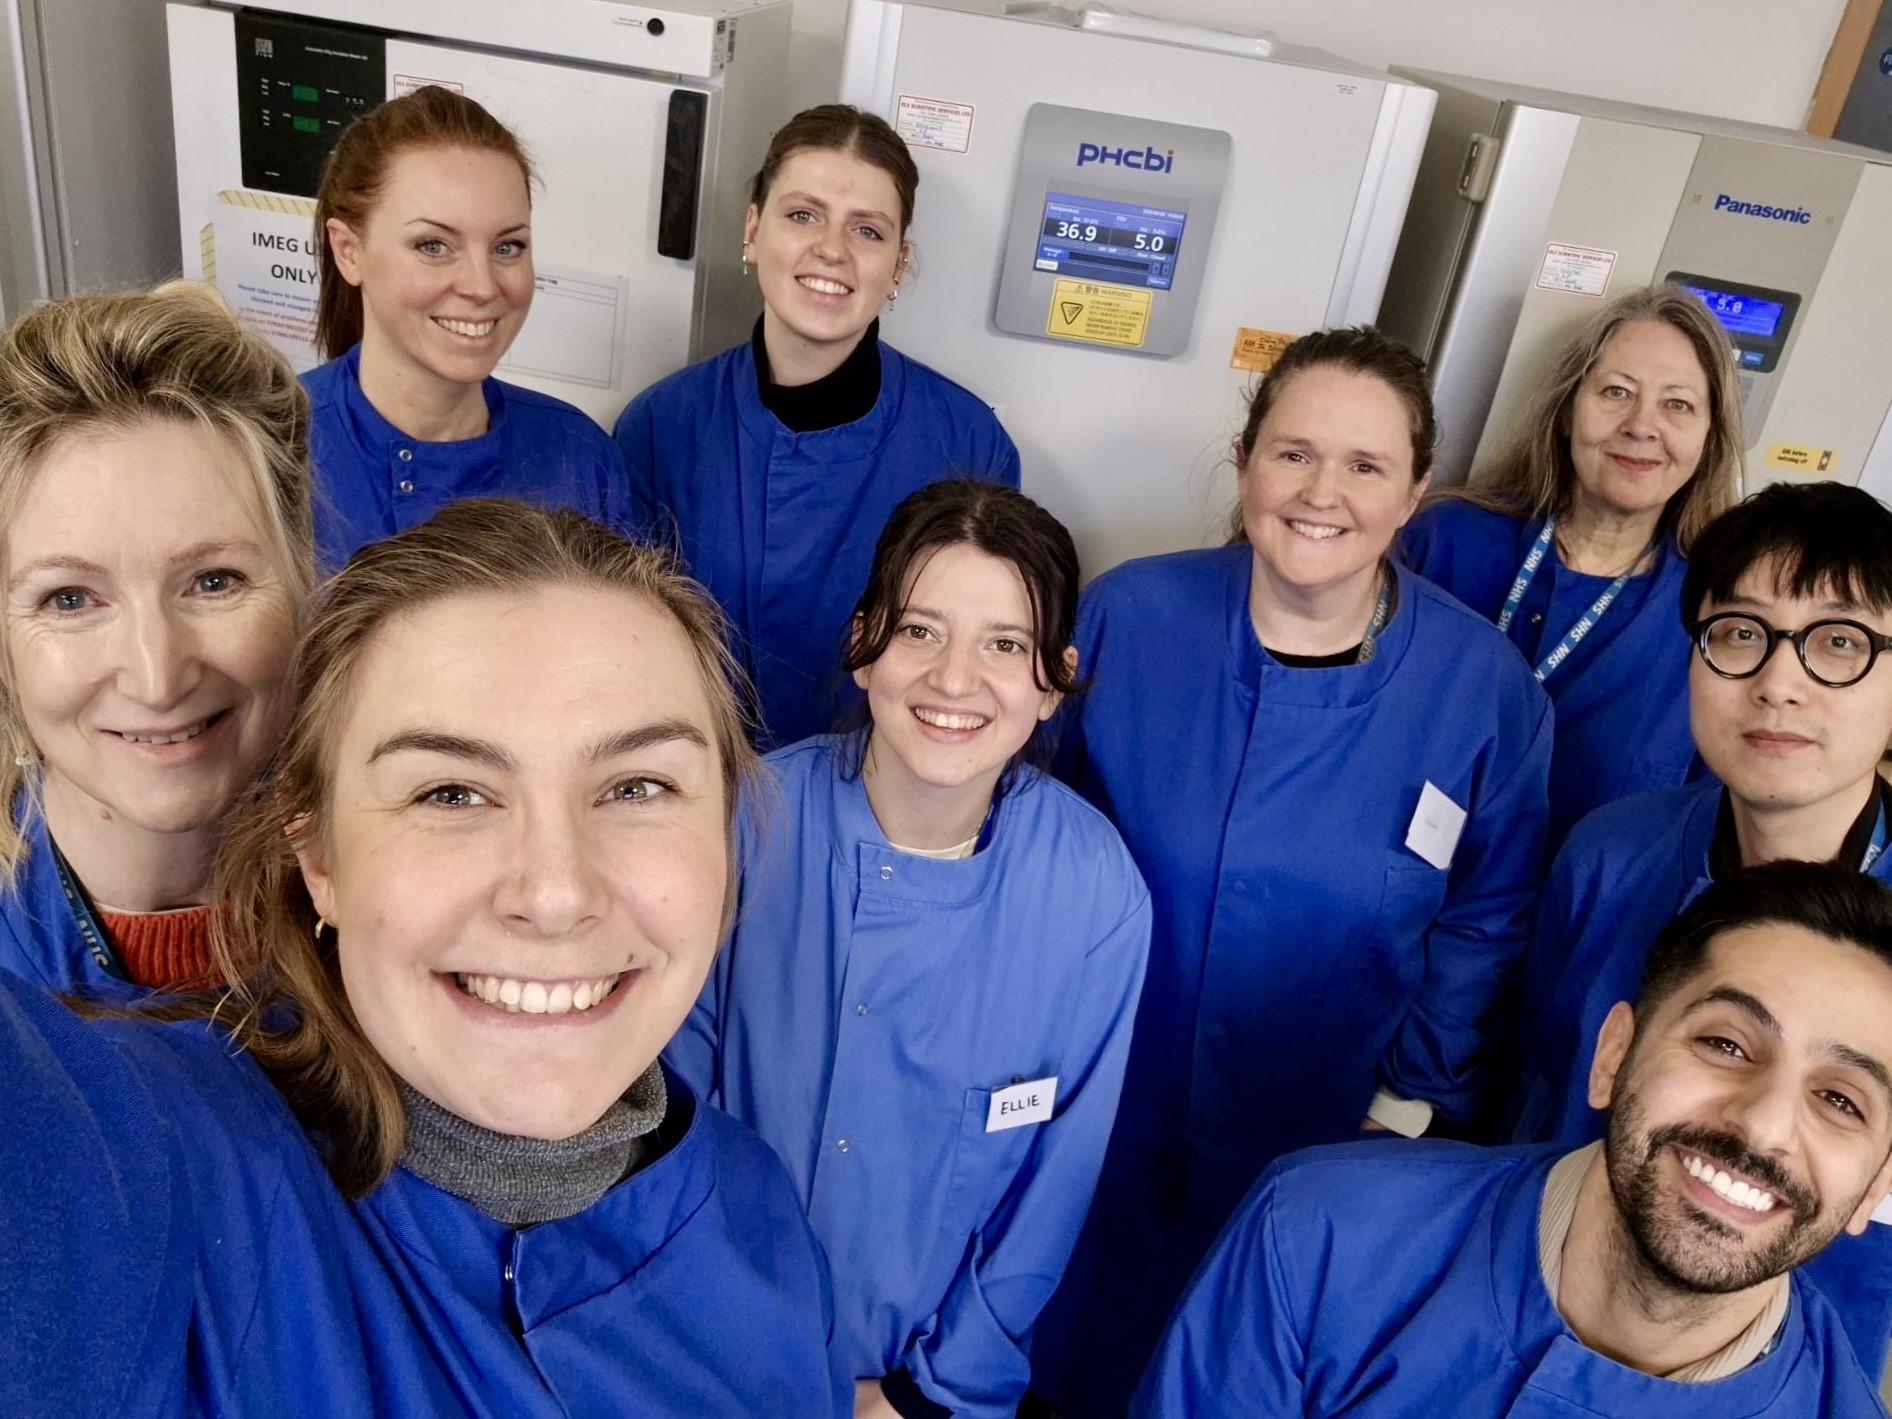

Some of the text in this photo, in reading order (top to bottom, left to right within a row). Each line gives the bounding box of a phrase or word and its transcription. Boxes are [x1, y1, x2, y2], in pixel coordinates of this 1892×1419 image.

[1714, 194, 1811, 224] Panasonic
[252, 231, 298, 253] IMEG
[1056, 221, 1163, 252] 36.9 5.0
[271, 264, 317, 285] ONLY
[1101, 289, 1132, 299] WARNING
[1716, 298, 1742, 314] 5.0
[1508, 577, 1528, 603] NHS
[1524, 547, 1543, 572] NHS
[1547, 592, 1614, 669] NHS NHS NHS
[1001, 1094, 1040, 1115] ELLIE
